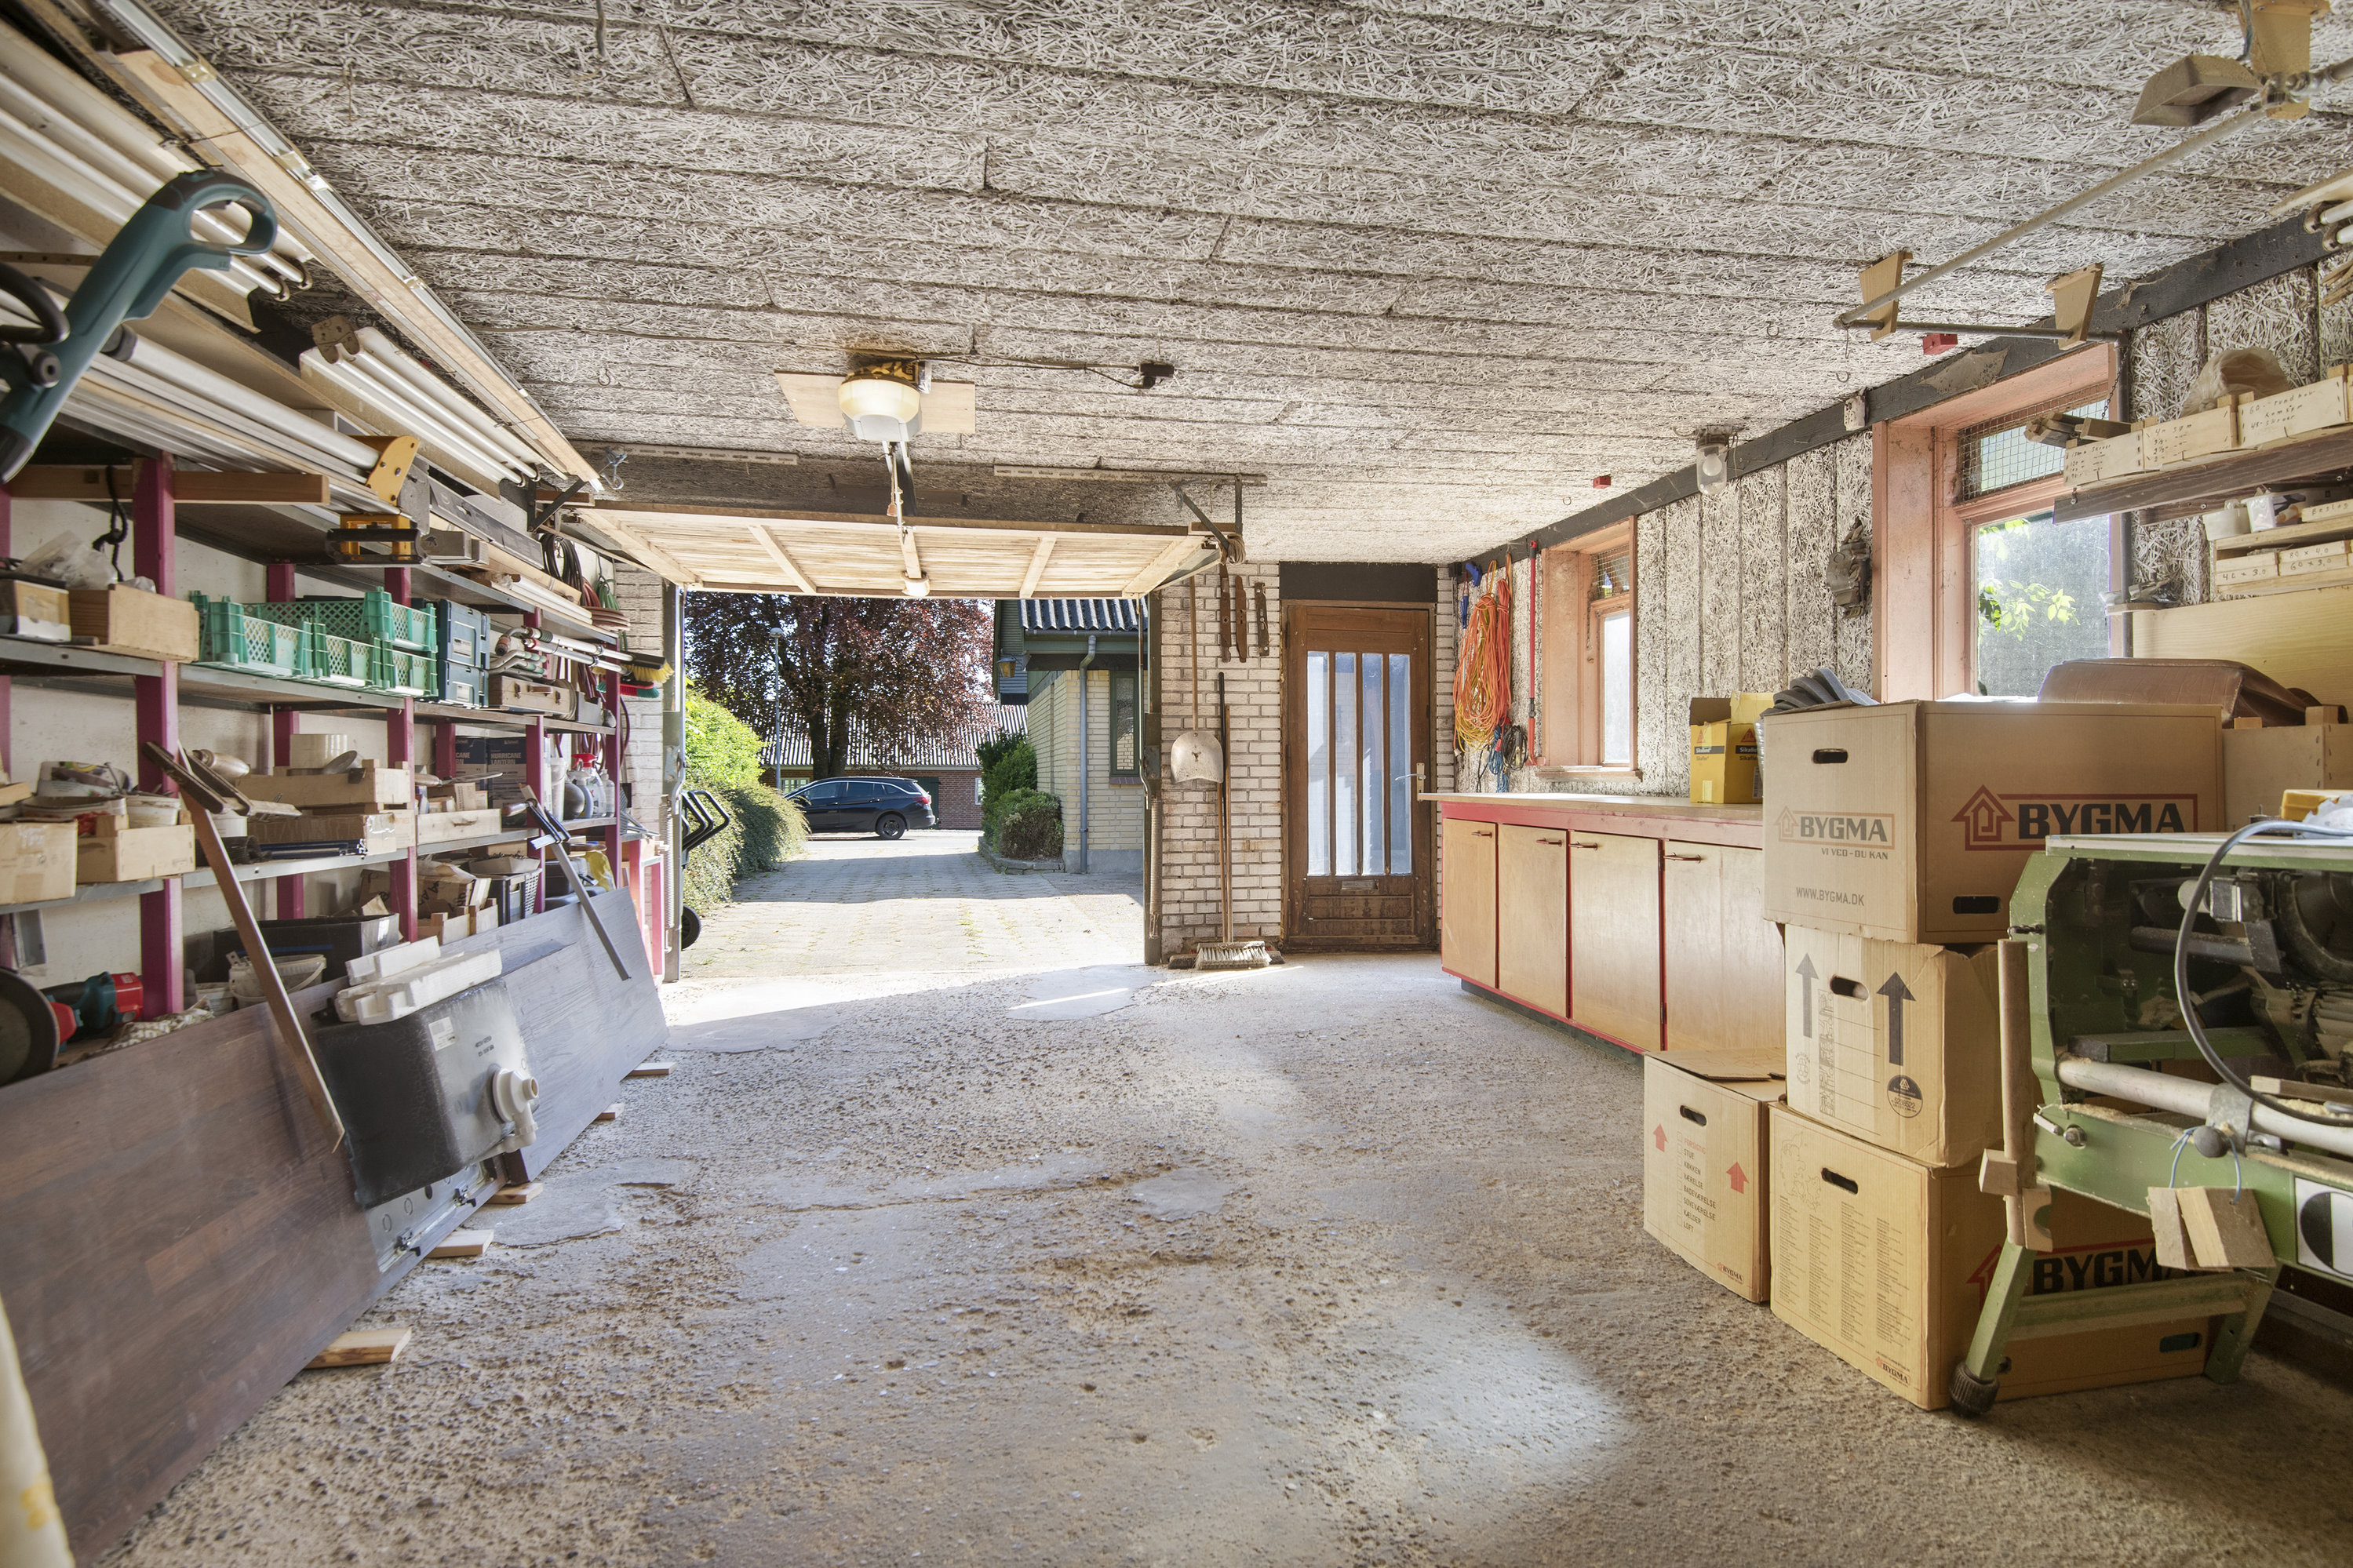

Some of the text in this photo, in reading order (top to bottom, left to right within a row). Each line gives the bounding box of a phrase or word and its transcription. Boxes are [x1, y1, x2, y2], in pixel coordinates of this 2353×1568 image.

[1800, 816, 1888, 842] BYGMA
[2019, 803, 2185, 839] BYGMA
[1869, 851, 1889, 860] KAN
[1796, 886, 1865, 907] WWW.BYGMA.DK
[1684, 1148, 1695, 1160] STUE
[1684, 1161, 1701, 1176] KØKKEN
[1683, 1173, 1703, 1190] VÆRELSE
[1684, 1184, 1717, 1209] BADEVÆRELSE
[1683, 1209, 1702, 1225] KÆLDER
[1683, 1221, 1694, 1233] LOFT
[1723, 1265, 1743, 1281] BYGMA
[2033, 1247, 2185, 1294] BYGM
[1883, 1363, 1908, 1384] BYGMA
